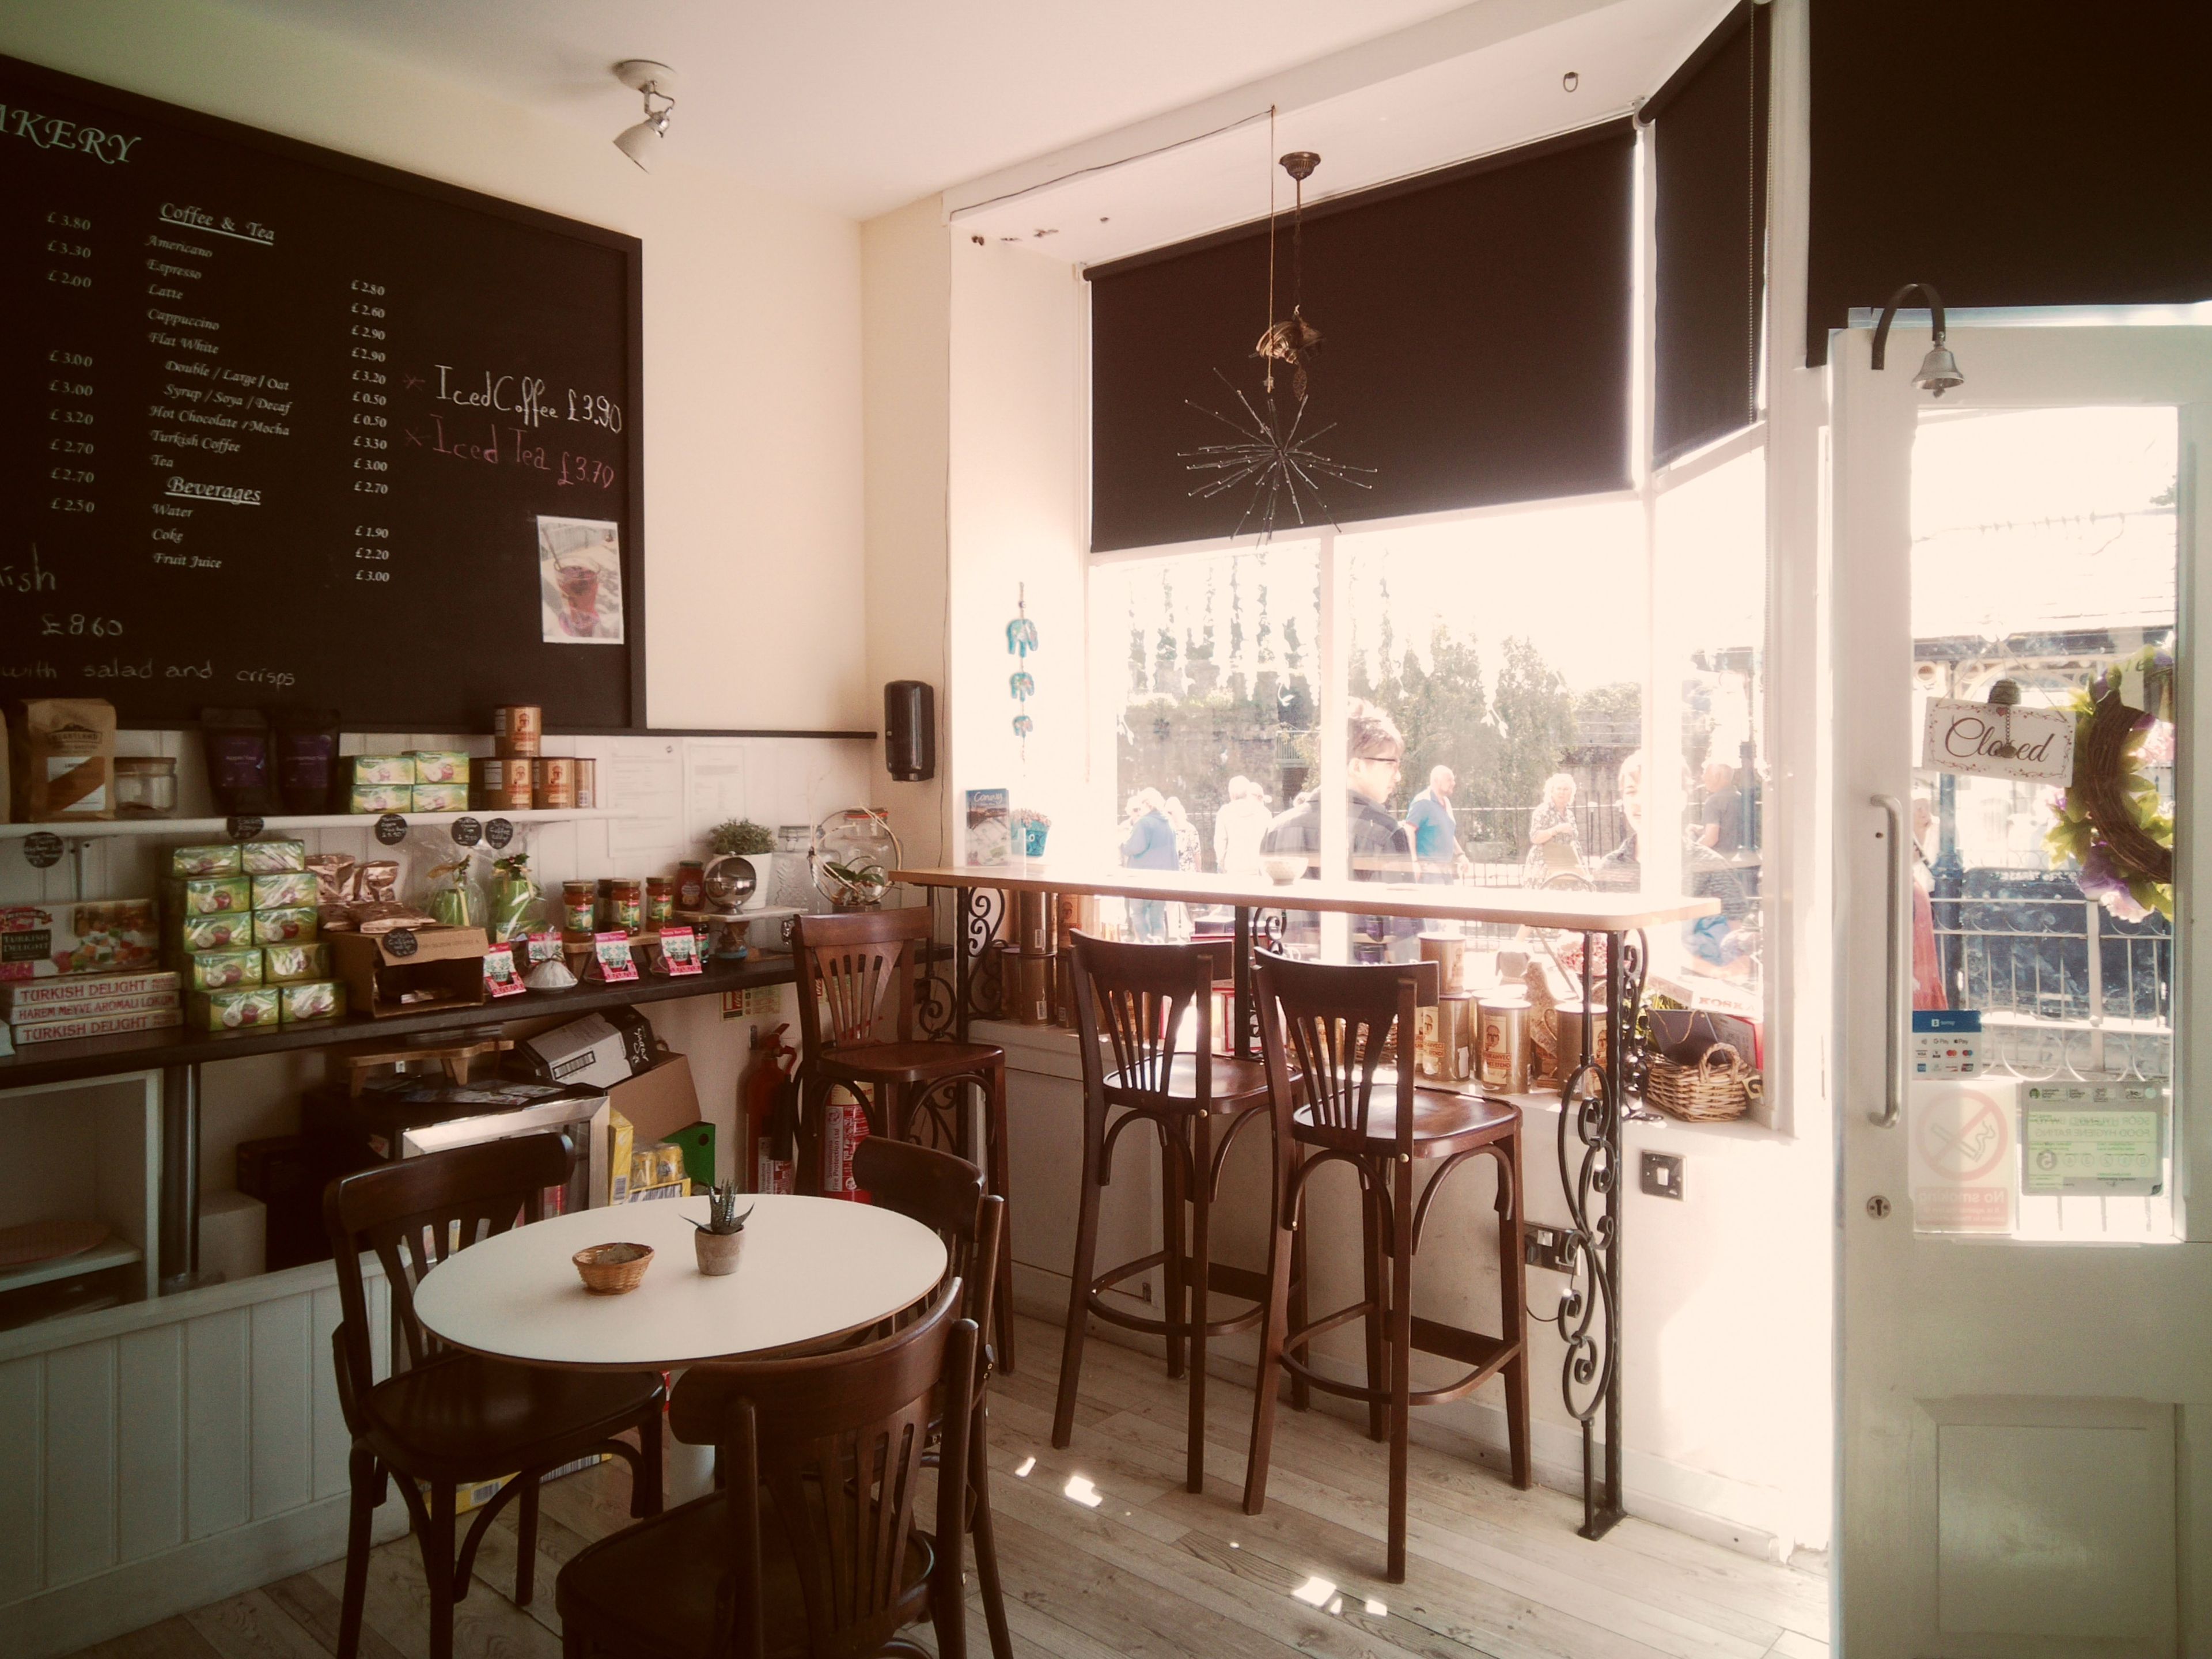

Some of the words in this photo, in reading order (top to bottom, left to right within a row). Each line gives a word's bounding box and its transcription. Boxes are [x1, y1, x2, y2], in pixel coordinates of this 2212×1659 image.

[160, 203, 214, 225] Coffee
[221, 216, 236, 232] &
[245, 221, 275, 240] Tea
[146, 235, 213, 257] Americano
[147, 259, 202, 279] Espresso
[148, 284, 183, 300] Latte
[147, 309, 219, 331] Cappuccino
[149, 332, 176, 346] Flat
[180, 338, 219, 354] White
[165, 361, 210, 376] Double
[223, 369, 257, 386] Large
[267, 378, 289, 391] Oat
[164, 384, 202, 403] Syrup
[213, 392, 243, 408] Soya
[256, 398, 293, 416] Decaf
[151, 406, 175, 419] Hot
[179, 410, 238, 429] Chocolate
[152, 430, 198, 447] Turkish
[202, 437, 240, 454] Coffee
[153, 454, 173, 468] Tea
[166, 477, 263, 502] Beverages
[152, 503, 193, 517] Water
[152, 528, 183, 544] Coke
[154, 552, 187, 566] Fruit
[190, 556, 222, 569] Juice
[82, 657, 154, 679] salad
[165, 659, 213, 679] and
[236, 667, 295, 694] crisps
[1945, 715, 2055, 763] Cloed
[974, 791, 1003, 805] Conwy
[20, 985, 84, 1002] TURKISH
[89, 980, 147, 996] DELIGHT
[19, 1006, 55, 1021] HAREM
[58, 1002, 93, 1015] MEYVE
[1698, 997, 1755, 1012] KOSKA
[22, 1024, 86, 1041] TURKISH
[90, 1017, 147, 1033] DELIGHT
